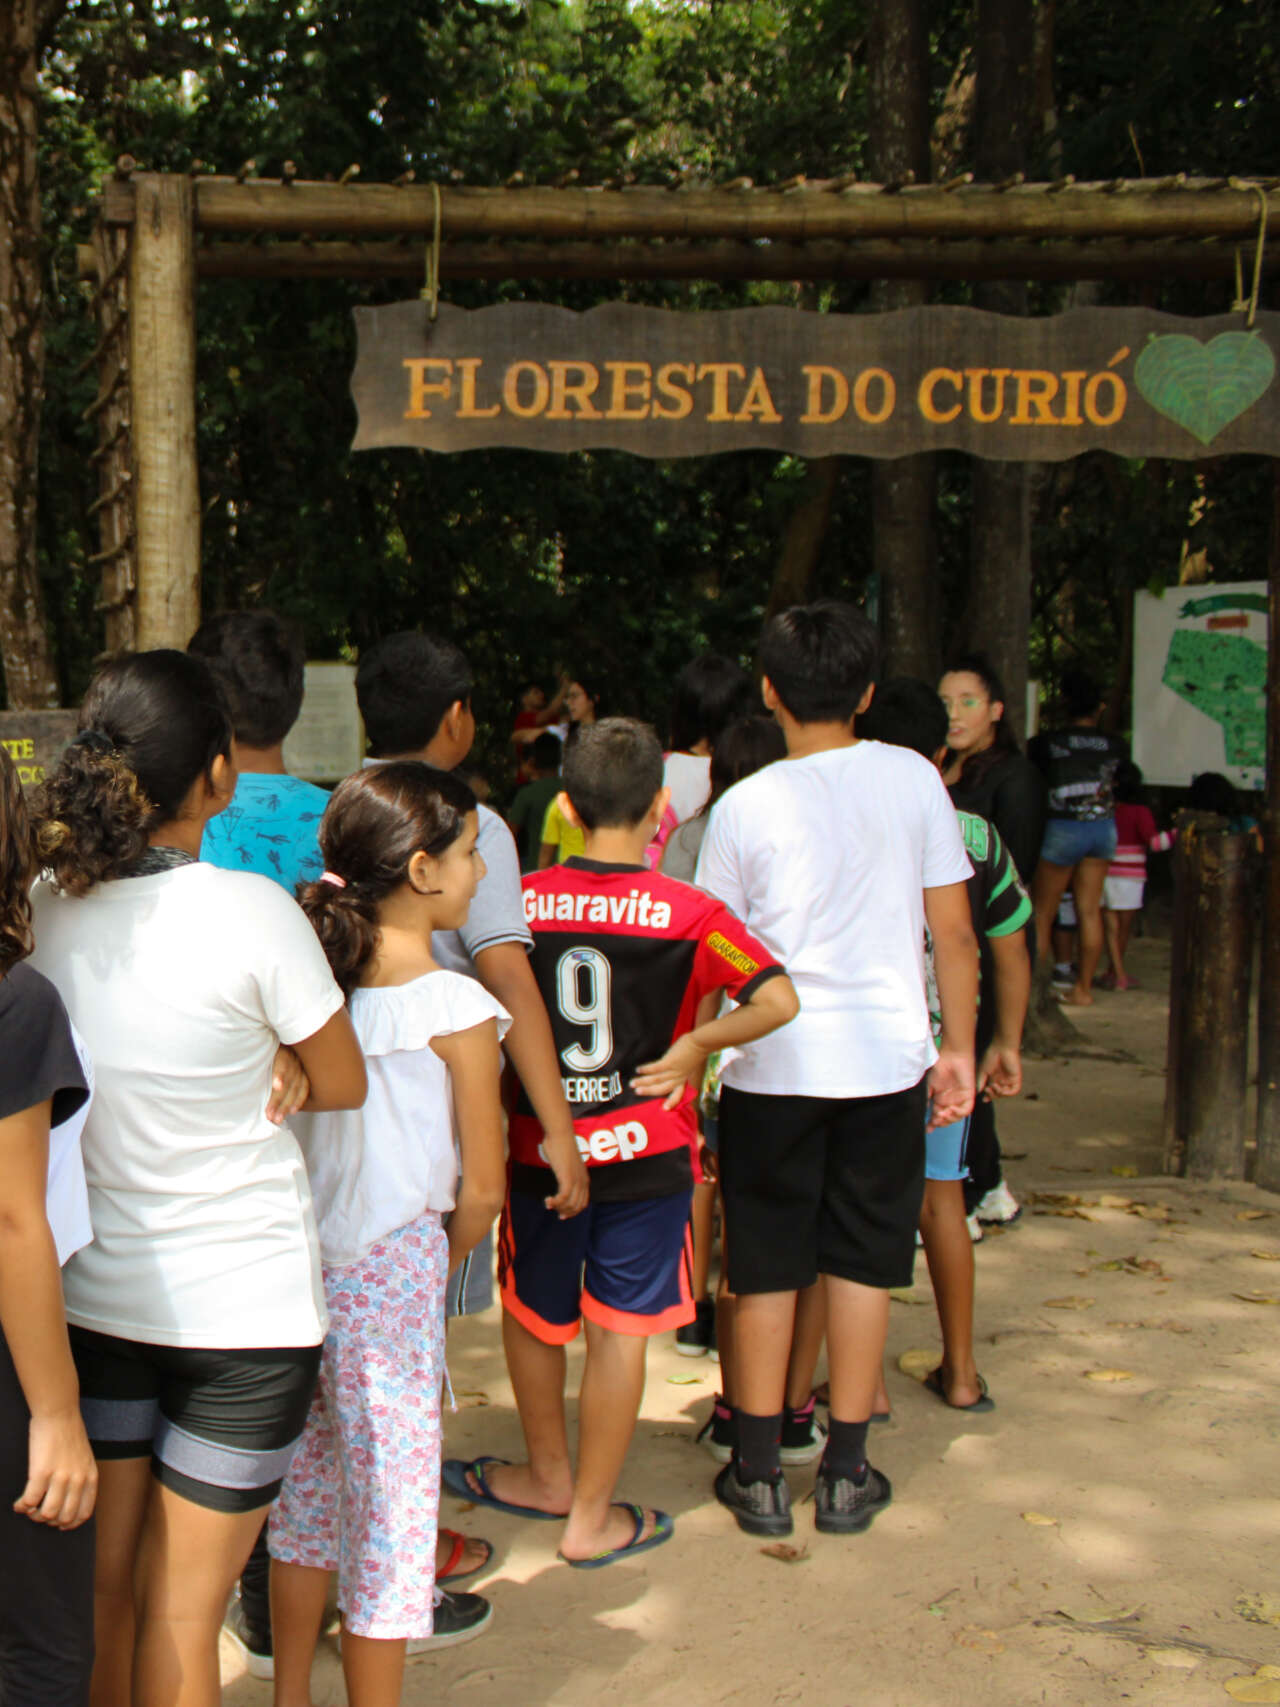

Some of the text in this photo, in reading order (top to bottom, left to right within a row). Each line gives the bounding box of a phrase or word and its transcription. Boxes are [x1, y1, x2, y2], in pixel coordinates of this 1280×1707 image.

[402, 345, 1133, 427] FLORESTA DO CURIÓ
[521, 888, 672, 929] Guaravita
[556, 946, 614, 1073] 9
